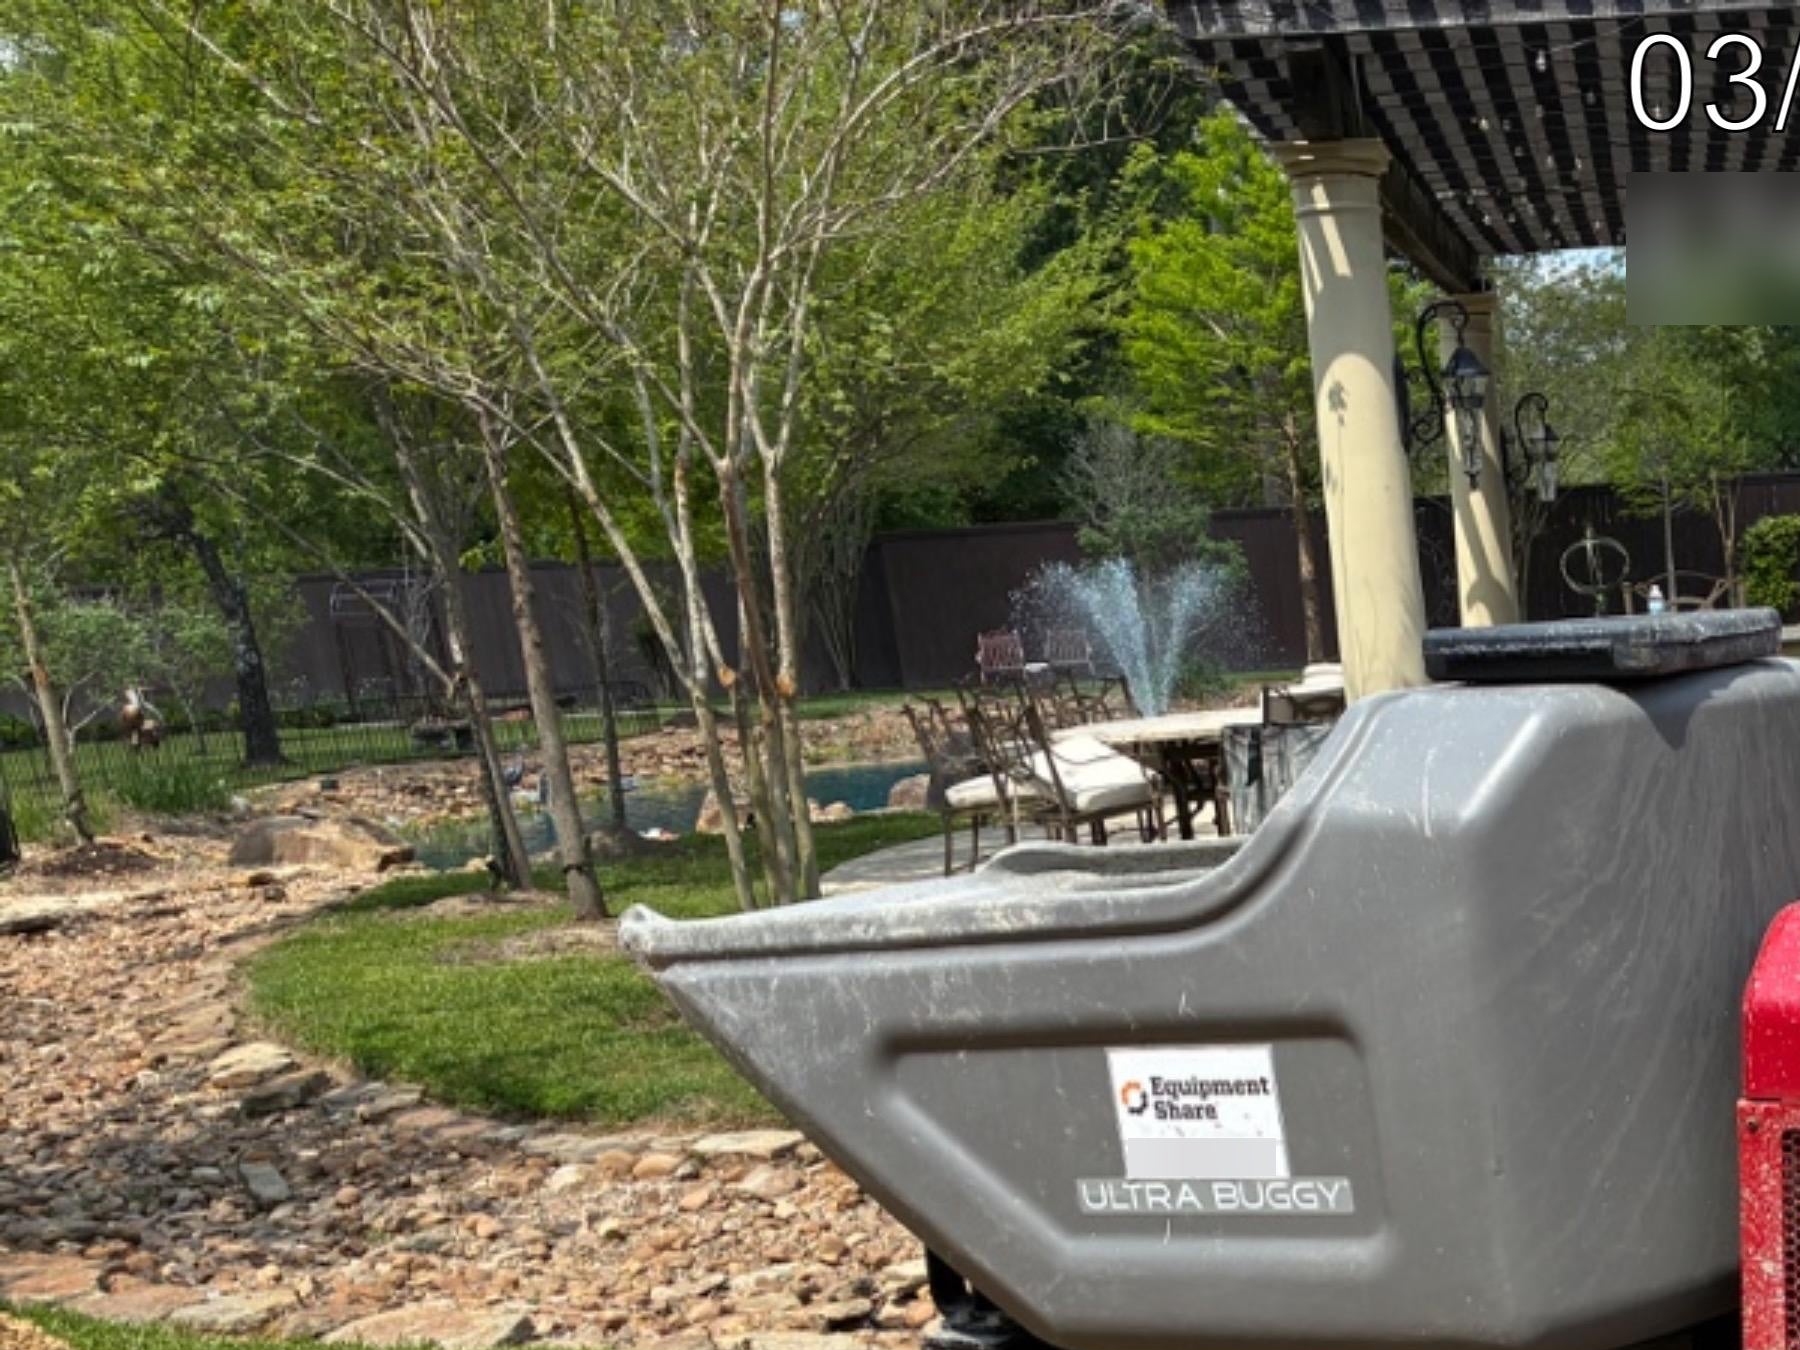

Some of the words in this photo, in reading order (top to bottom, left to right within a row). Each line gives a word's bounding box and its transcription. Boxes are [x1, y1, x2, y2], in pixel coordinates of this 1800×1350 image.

[1150, 1076, 1270, 1100] Equipment
[1154, 1101, 1218, 1120] Share
[1081, 1182, 1204, 1209] ULTRA
[1212, 1182, 1345, 1208] BUGGY
